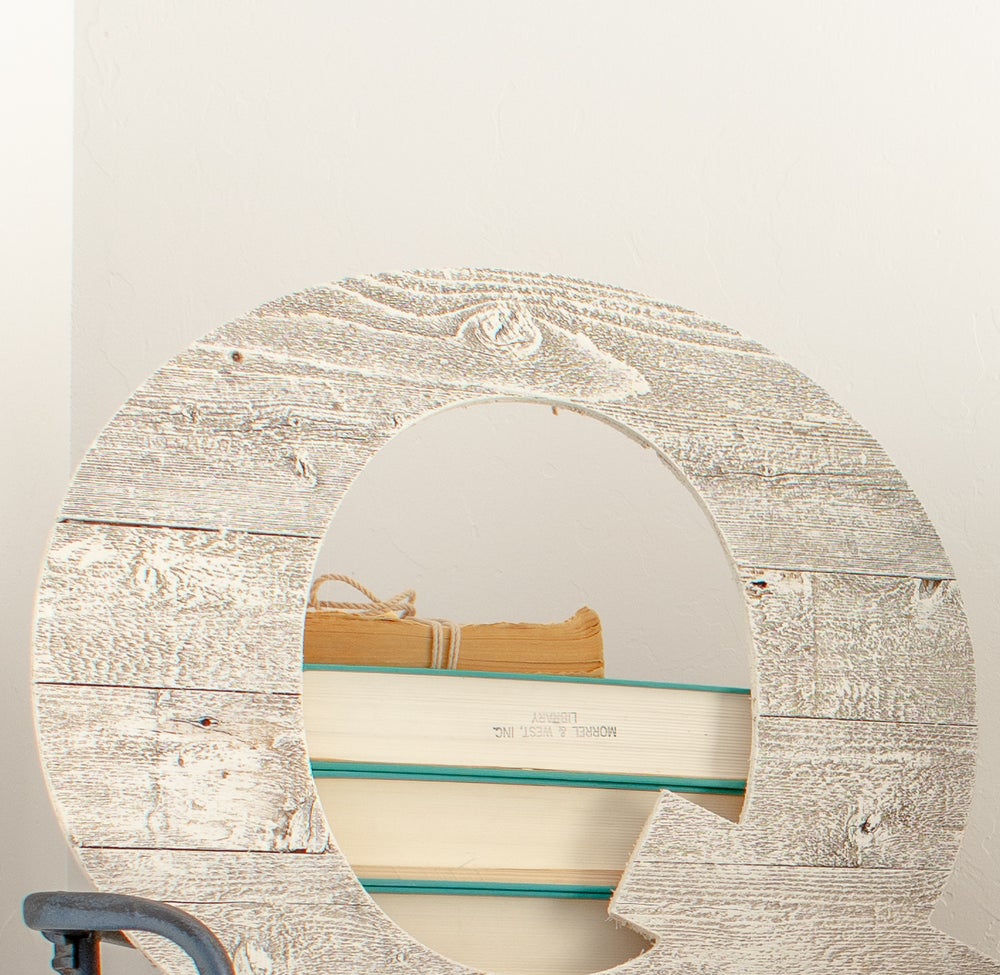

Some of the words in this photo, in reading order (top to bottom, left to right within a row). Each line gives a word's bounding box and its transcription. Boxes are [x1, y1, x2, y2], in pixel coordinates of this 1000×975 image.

[531, 712, 577, 723] LIBRARY
[493, 726, 514, 738] INC.
[558, 726, 567, 738] &
[572, 726, 617, 738] MORREL
